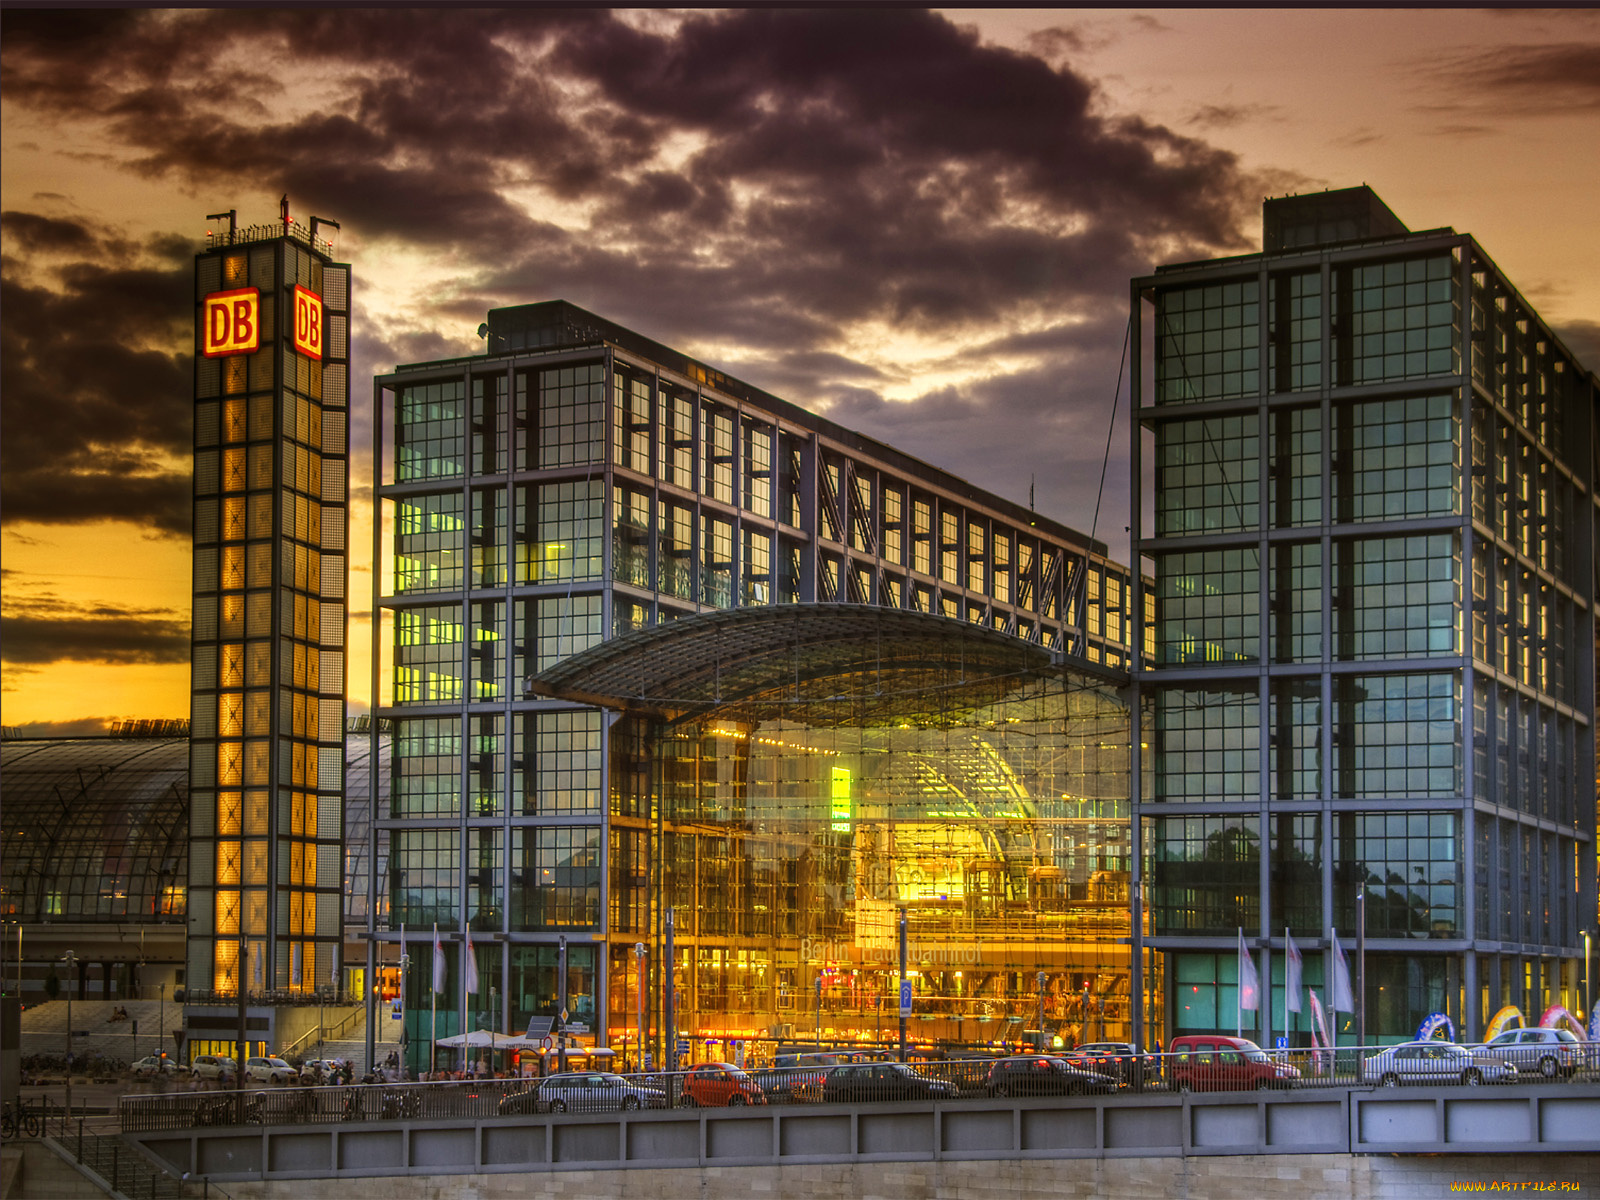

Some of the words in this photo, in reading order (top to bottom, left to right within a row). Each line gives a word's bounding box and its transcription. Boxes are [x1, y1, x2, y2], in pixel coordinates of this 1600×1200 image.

[210, 300, 253, 347] DB
[298, 297, 319, 348] DB
[801, 938, 848, 961] Berlin
